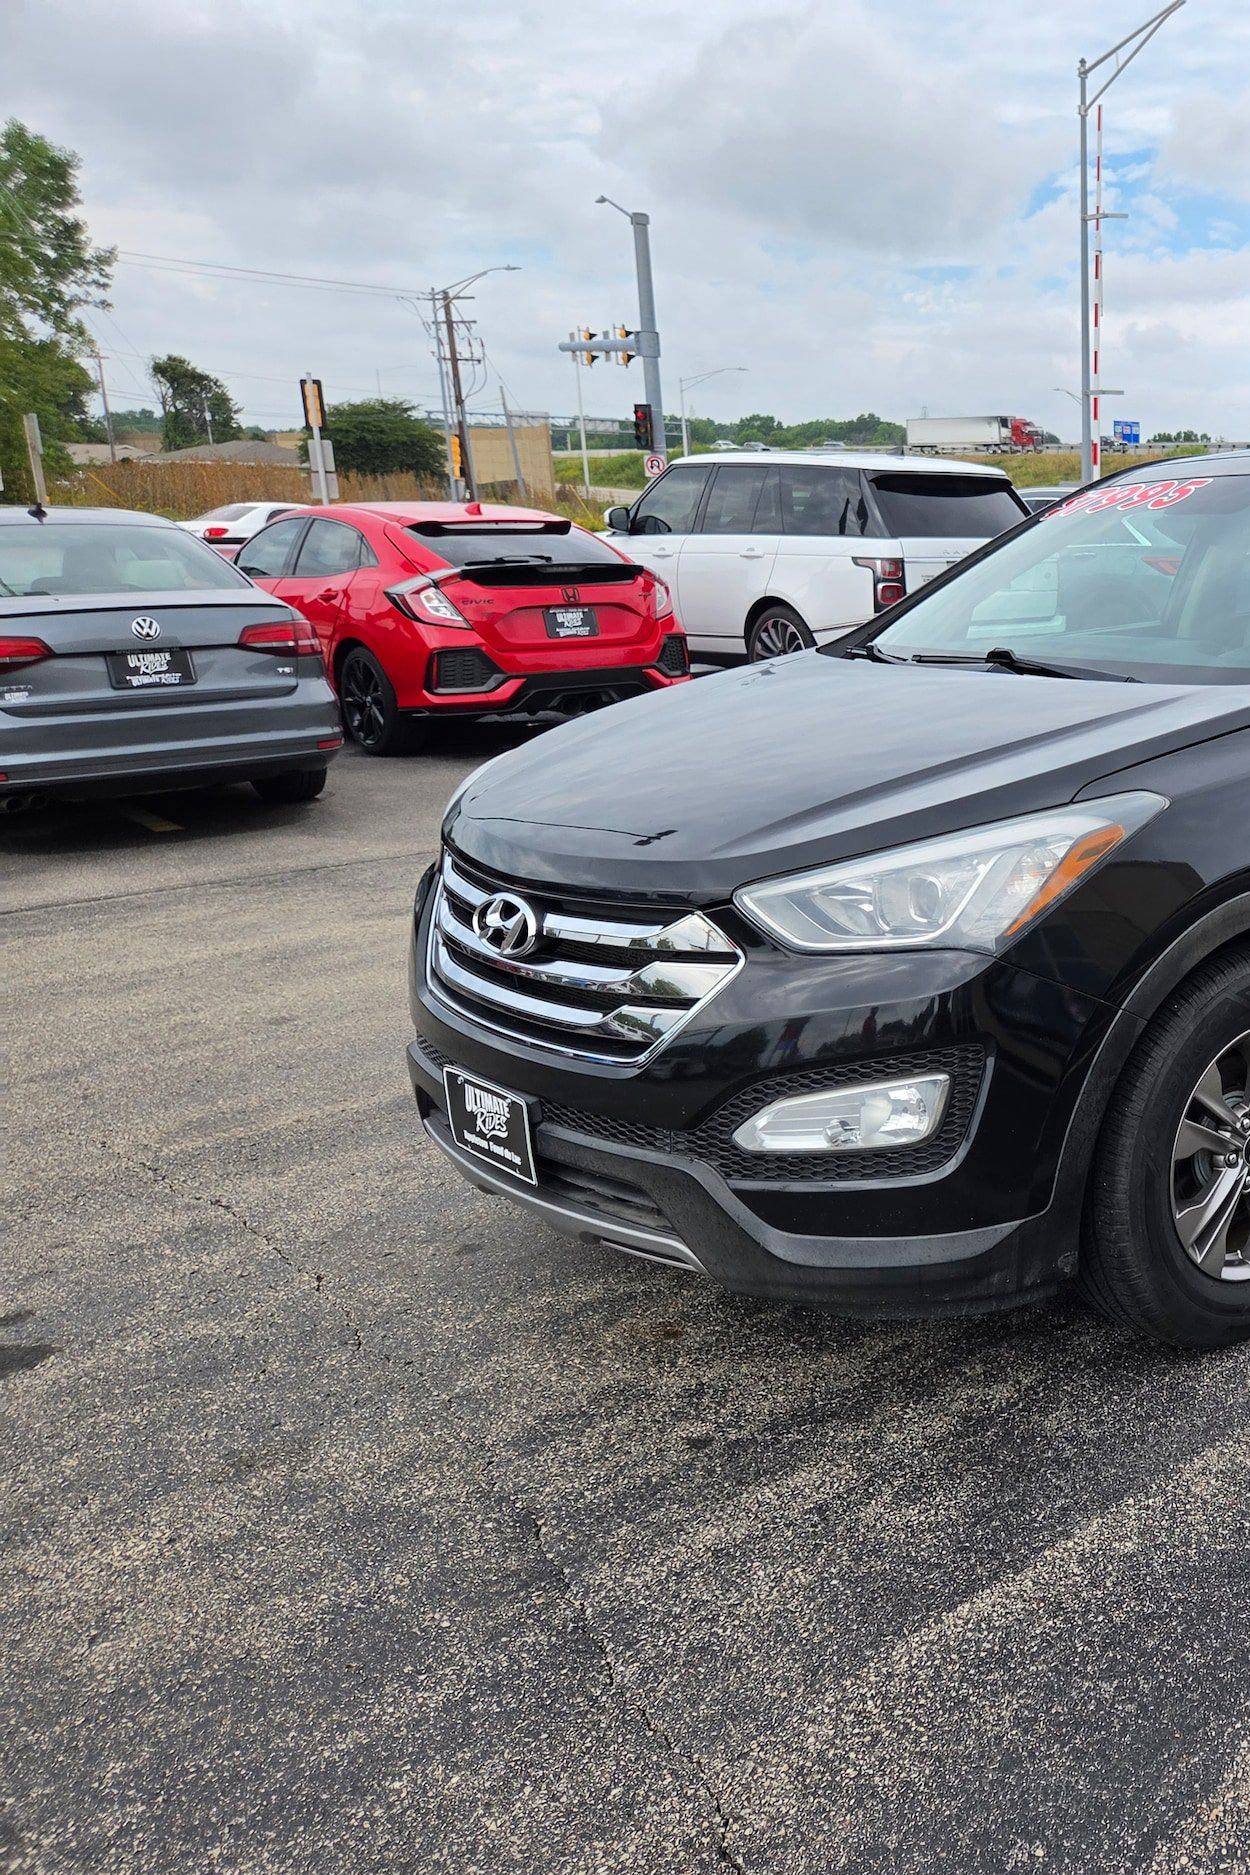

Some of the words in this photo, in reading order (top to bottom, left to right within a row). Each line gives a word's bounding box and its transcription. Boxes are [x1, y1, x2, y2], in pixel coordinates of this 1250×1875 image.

[127, 652, 171, 668] ULTIMATE
[464, 1083, 511, 1118] ULTIMATE
[474, 1107, 508, 1139] RIDES
